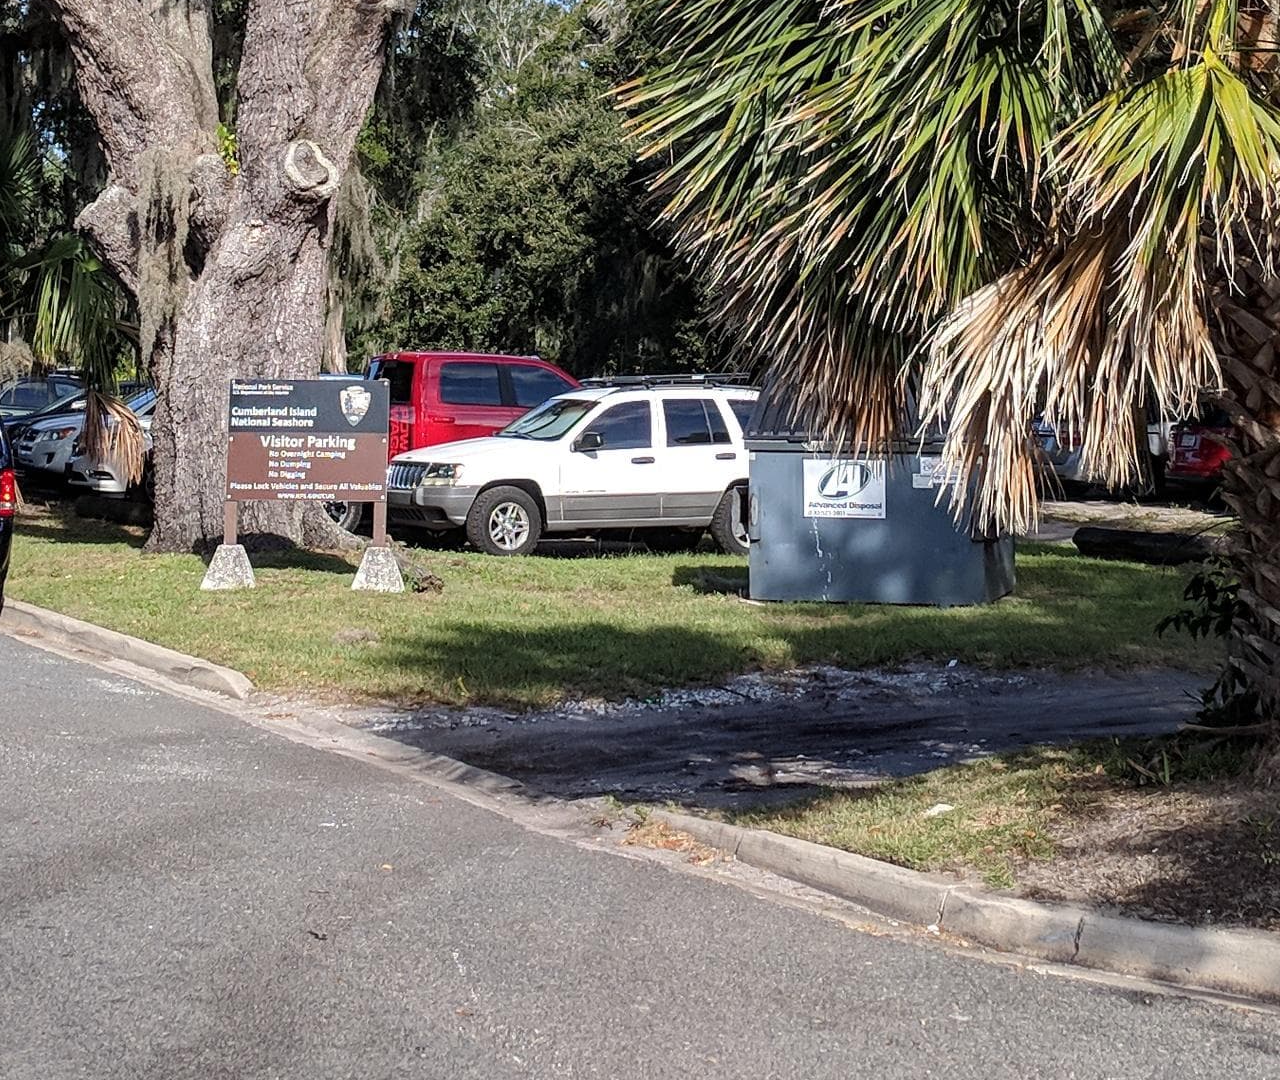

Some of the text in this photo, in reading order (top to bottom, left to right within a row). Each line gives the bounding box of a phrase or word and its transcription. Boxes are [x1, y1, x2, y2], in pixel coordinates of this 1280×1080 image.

[231, 406, 317, 417] Cumberland Island
[231, 417, 314, 427] National Seashore
[260, 434, 356, 451] Visitor Parking
[269, 450, 346, 459] No Overnight Camping
[268, 460, 312, 469] No Dumping
[268, 470, 306, 479] No Digging
[230, 482, 383, 491] Please Lock Vehicles and Secure All Valuables
[808, 501, 882, 510] Advanced Disposal
